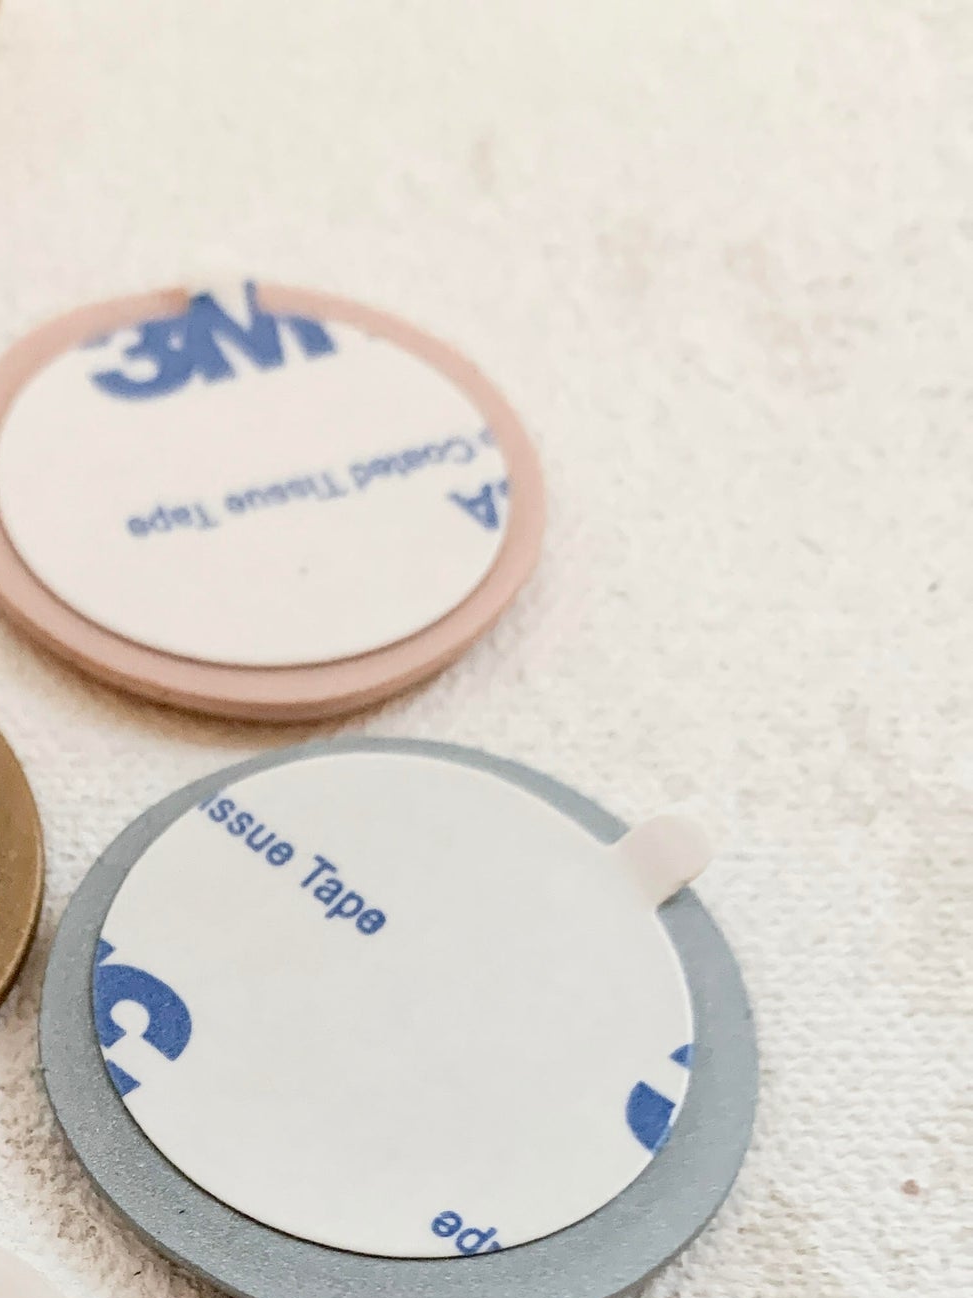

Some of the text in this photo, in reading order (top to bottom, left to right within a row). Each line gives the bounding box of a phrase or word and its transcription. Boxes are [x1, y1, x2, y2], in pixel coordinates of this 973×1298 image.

[224, 471, 347, 514] Tissue
[448, 477, 508, 532] A
[125, 502, 218, 537] Tape
[301, 854, 388, 936] Tape
[430, 1209, 502, 1257] pe
